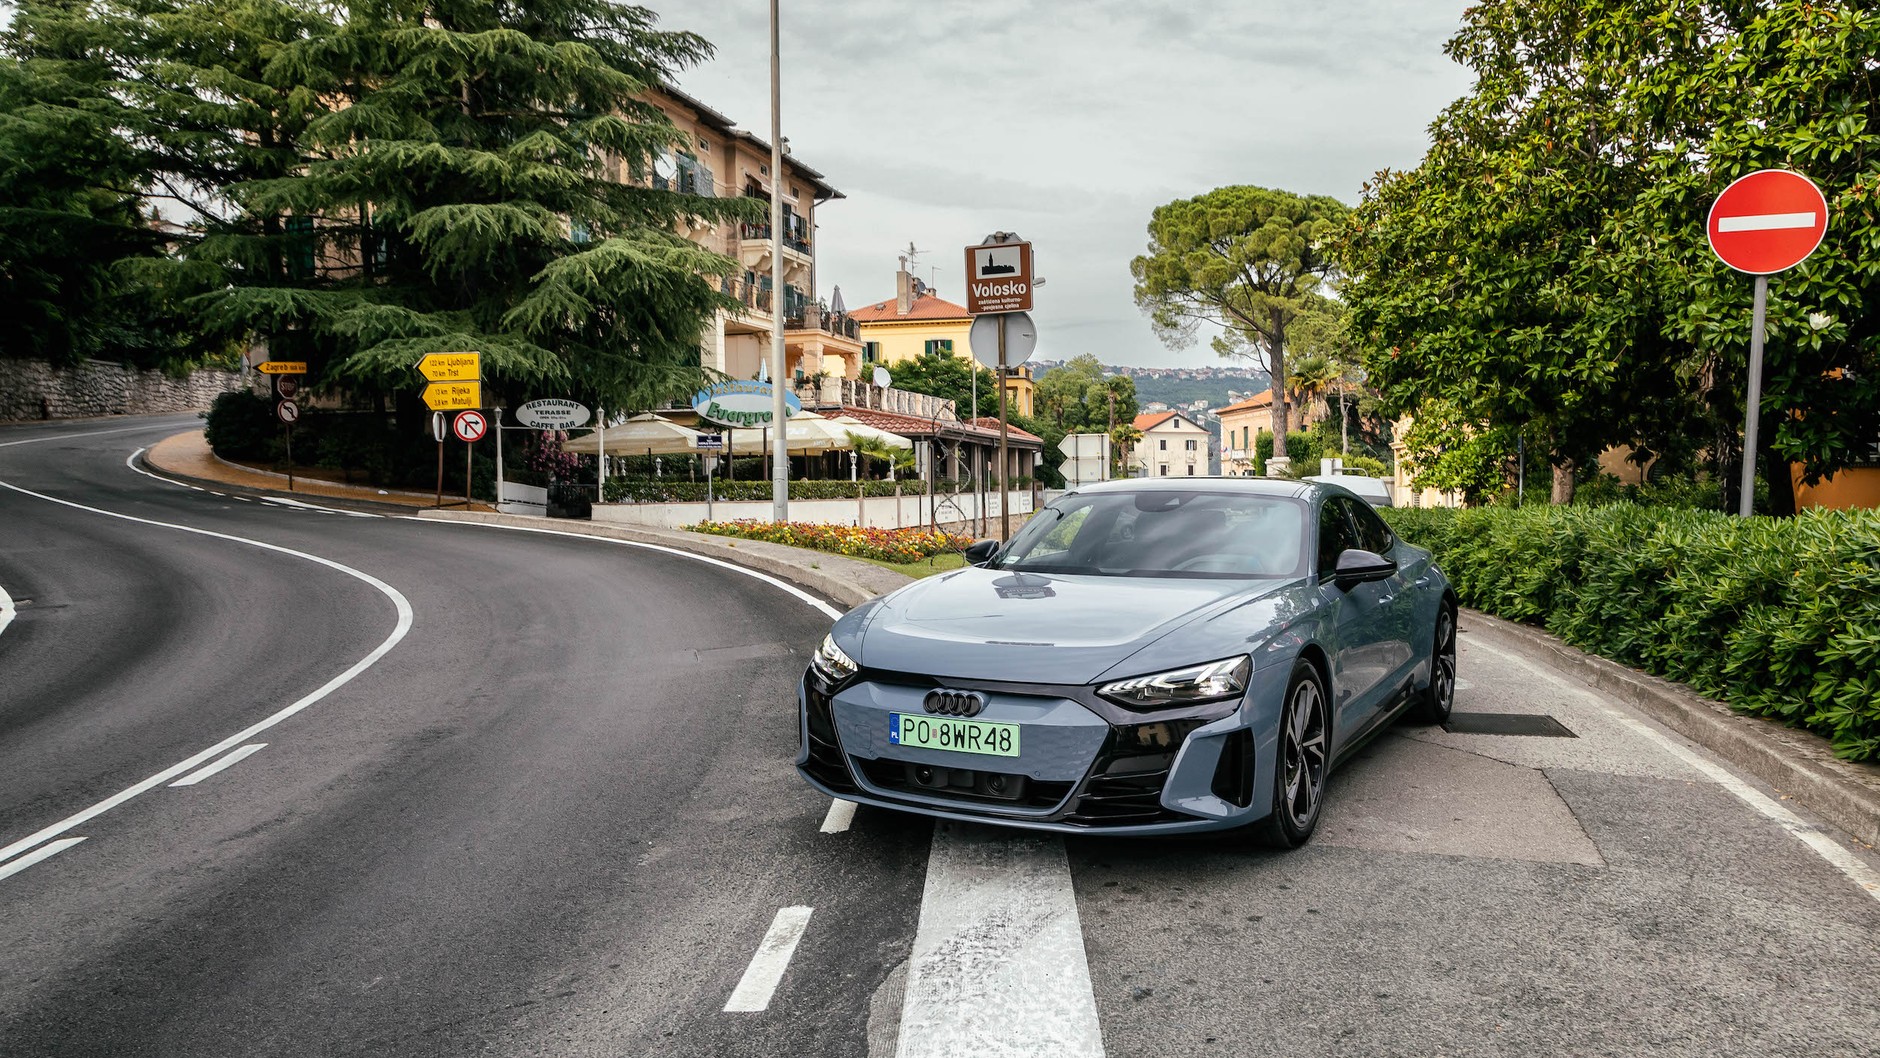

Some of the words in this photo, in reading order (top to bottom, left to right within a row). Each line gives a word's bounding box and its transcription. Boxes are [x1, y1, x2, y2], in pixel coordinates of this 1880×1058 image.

[972, 280, 1027, 298] Volosko
[447, 357, 474, 367] Ljubljana
[266, 363, 288, 372] Zagreb
[281, 382, 295, 391] STOP
[452, 387, 470, 396] Rijeka
[452, 397, 472, 406] Matulji
[525, 399, 580, 410] RESTAURANT
[530, 420, 555, 429] CAFFE
[559, 420, 576, 429] BAR
[891, 731, 899, 739] PL
